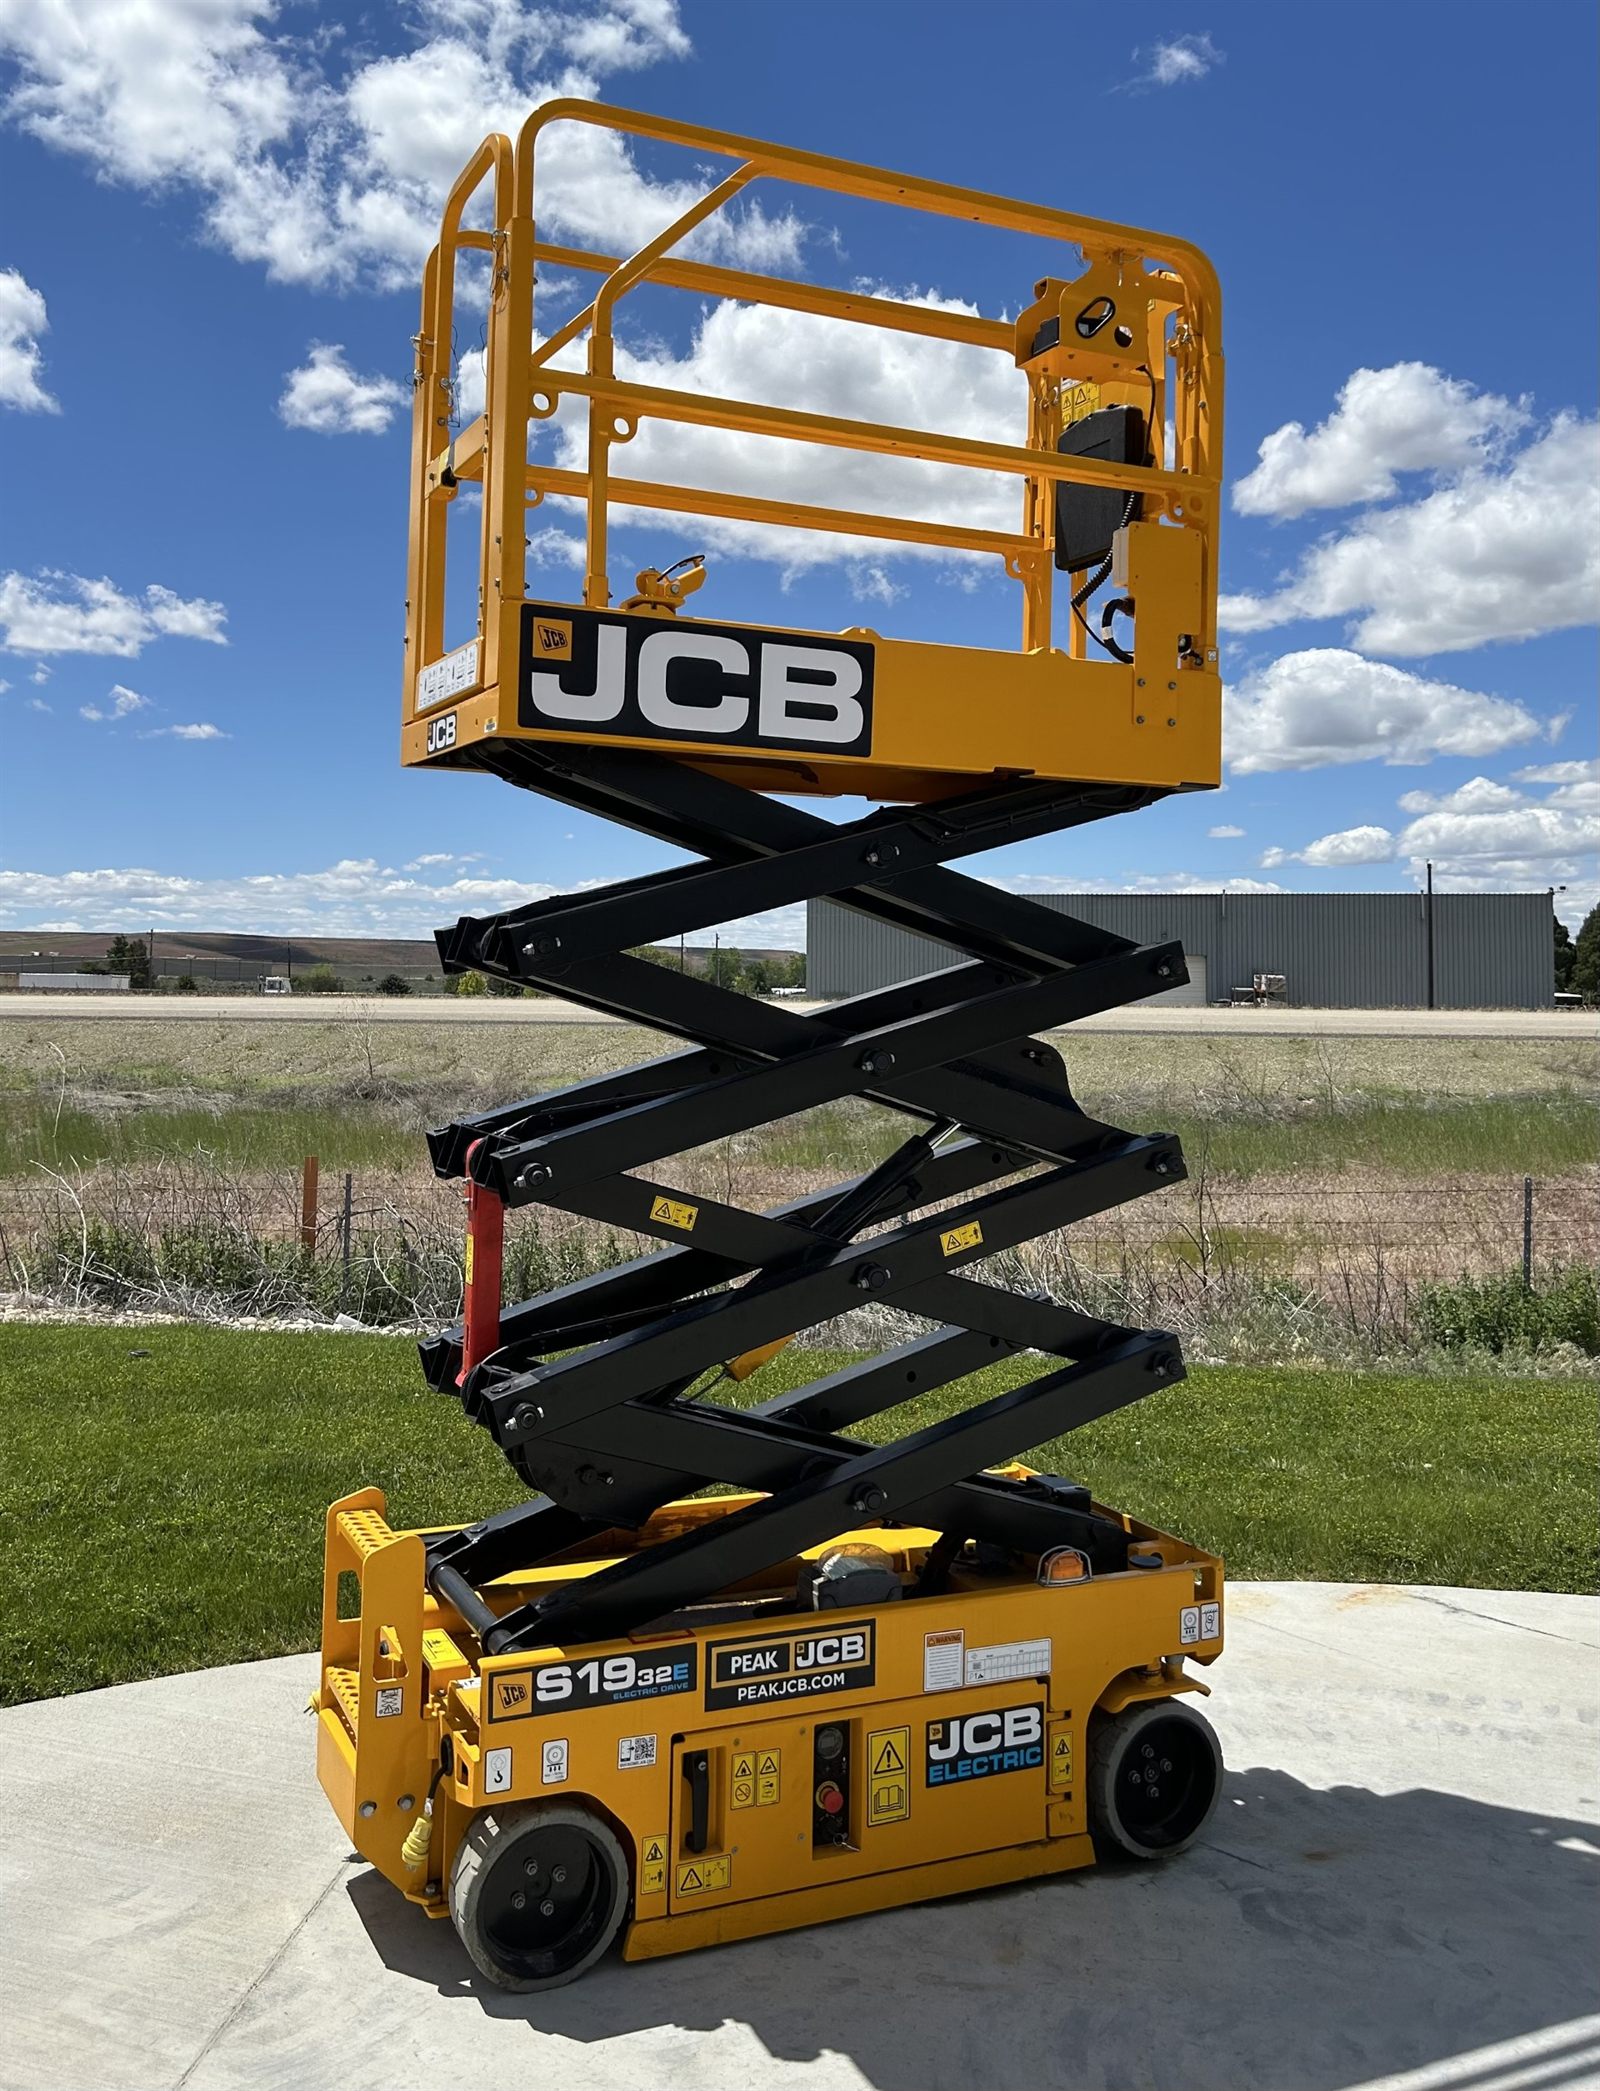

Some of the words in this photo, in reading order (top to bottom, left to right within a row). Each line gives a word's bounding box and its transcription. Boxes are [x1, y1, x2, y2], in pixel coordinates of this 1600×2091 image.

[543, 628, 566, 649] JCB
[531, 623, 864, 744] JCB
[427, 714, 457, 753] JCB
[730, 1650, 779, 1675] PEAK
[796, 1635, 865, 1668] JCB
[503, 1686, 526, 1706] JCB
[613, 1685, 658, 1701] ELECTRIC
[660, 1682, 689, 1692] DRIVE
[737, 1672, 846, 1701] PEAKJCB.COM
[929, 1706, 1042, 1761] JCB
[928, 1746, 1042, 1784] ELECTRIC
